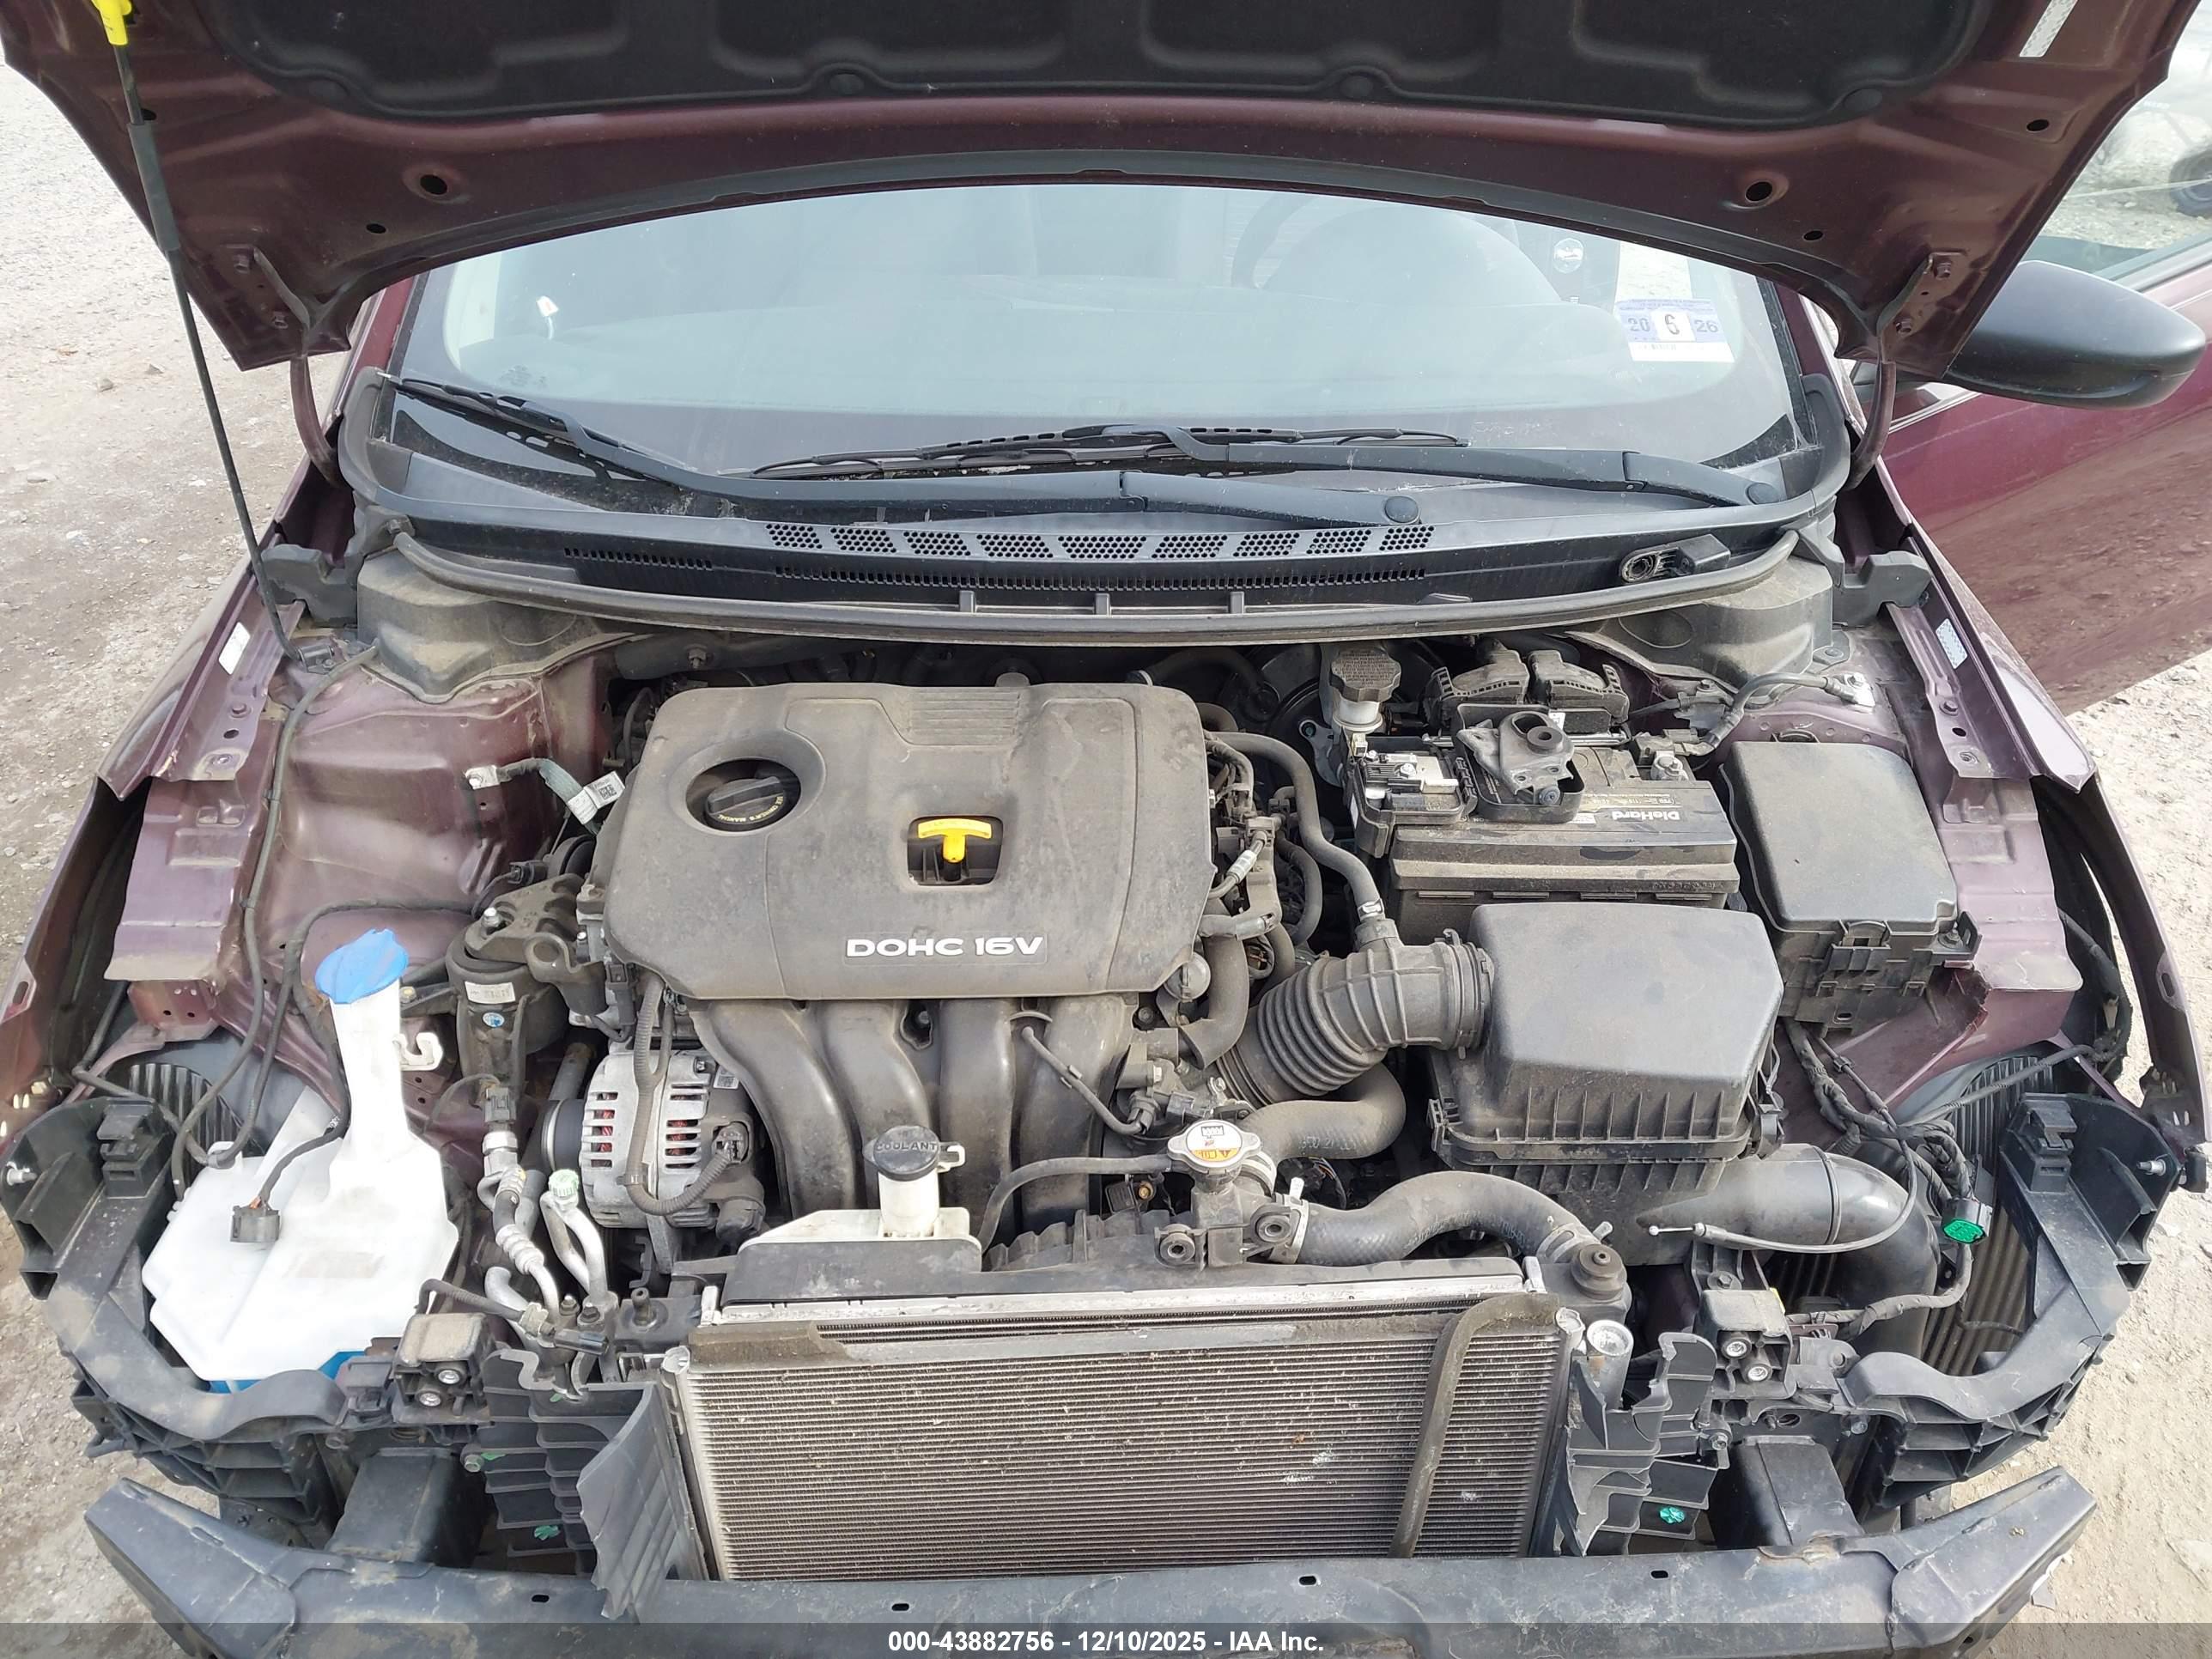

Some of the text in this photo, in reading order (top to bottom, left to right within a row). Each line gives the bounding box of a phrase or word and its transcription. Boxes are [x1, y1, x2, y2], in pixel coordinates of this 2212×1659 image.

[1627, 313, 1718, 335] 20 6 26
[1612, 810, 1680, 821] DieHard
[847, 937, 1043, 957] DOHC 16V
[876, 1139, 938, 1152] COOLANT
